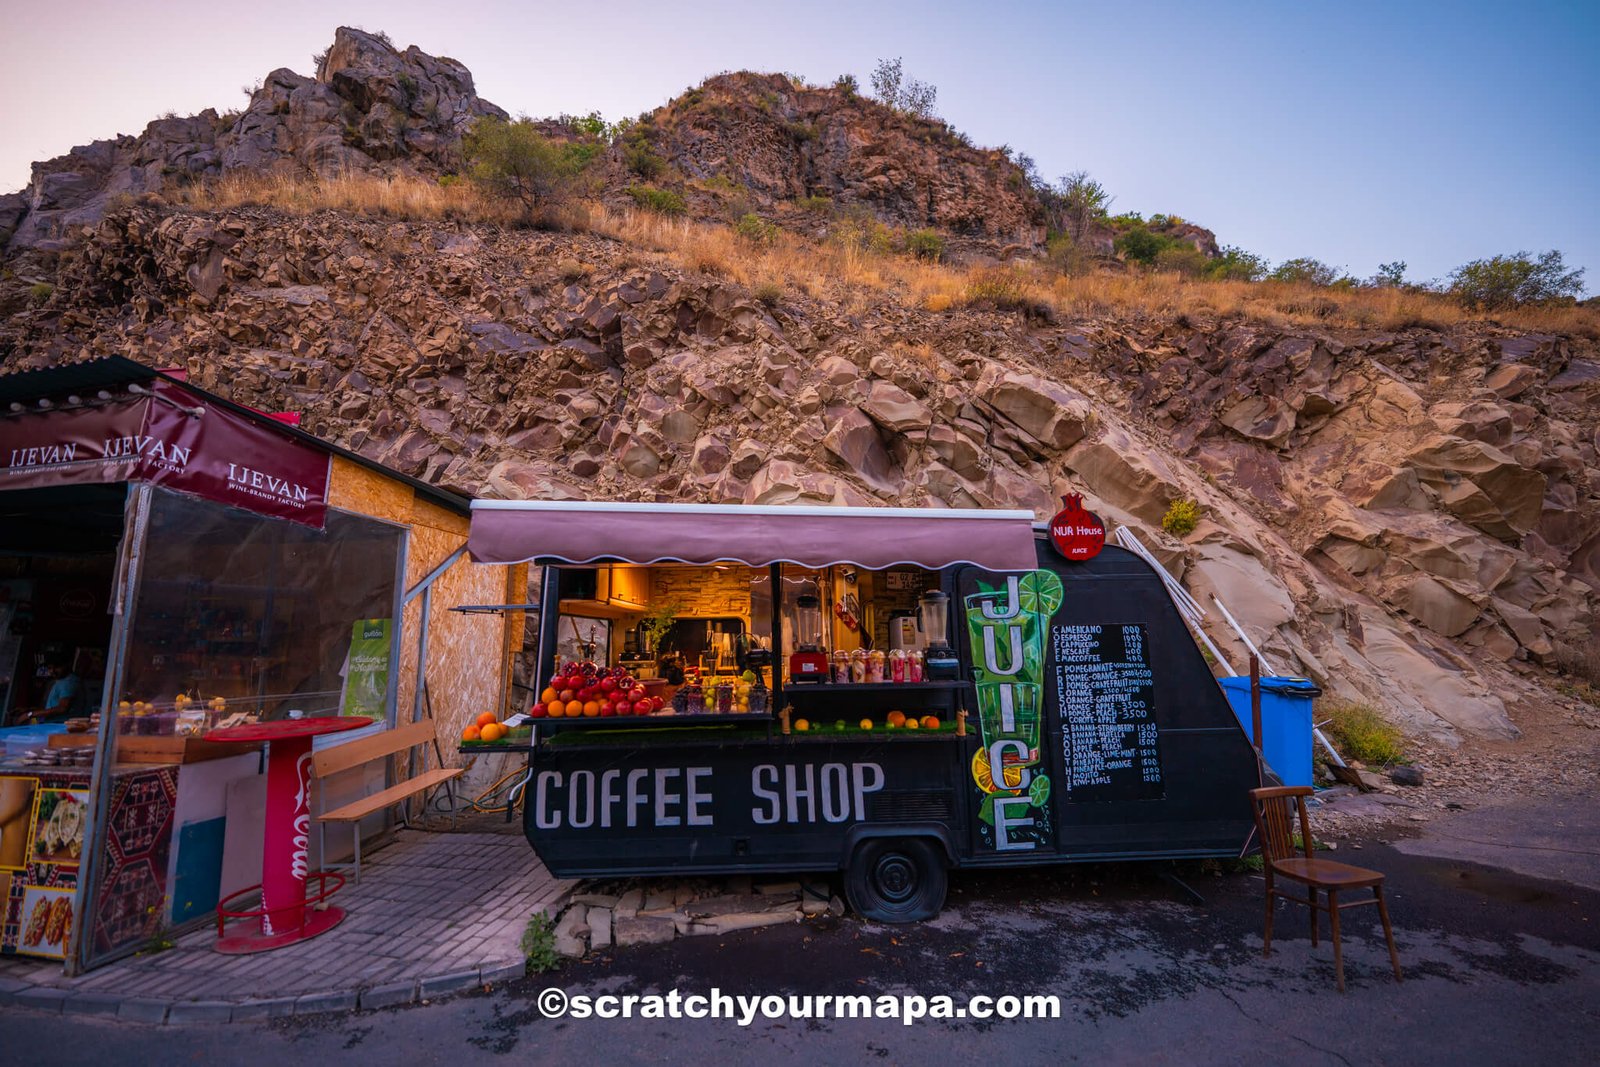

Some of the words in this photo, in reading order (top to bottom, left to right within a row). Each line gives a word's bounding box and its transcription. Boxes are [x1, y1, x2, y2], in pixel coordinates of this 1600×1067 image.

[9, 443, 77, 468] IJEVAN
[104, 435, 192, 466] IJEVAN
[148, 459, 186, 475] FACTORY
[227, 462, 309, 502] IJEVAN
[228, 482, 276, 501] WINE-BRANDY
[278, 497, 305, 509] FACTORY
[1053, 526, 1074, 536] NUR
[1076, 525, 1102, 535] House
[1061, 626, 1102, 634] AMERICANO
[1122, 626, 1140, 634] 1000
[1123, 634, 1142, 642] 1000
[1065, 663, 1113, 674] POMEGRANATE
[982, 575, 1035, 851] JUICE
[1137, 723, 1156, 731] 1500
[1101, 743, 1122, 751] PEACH
[1073, 771, 1099, 779] MOJITO
[1143, 774, 1161, 782] 1500
[535, 766, 714, 830] COFFEE
[751, 762, 885, 826] SHOP
